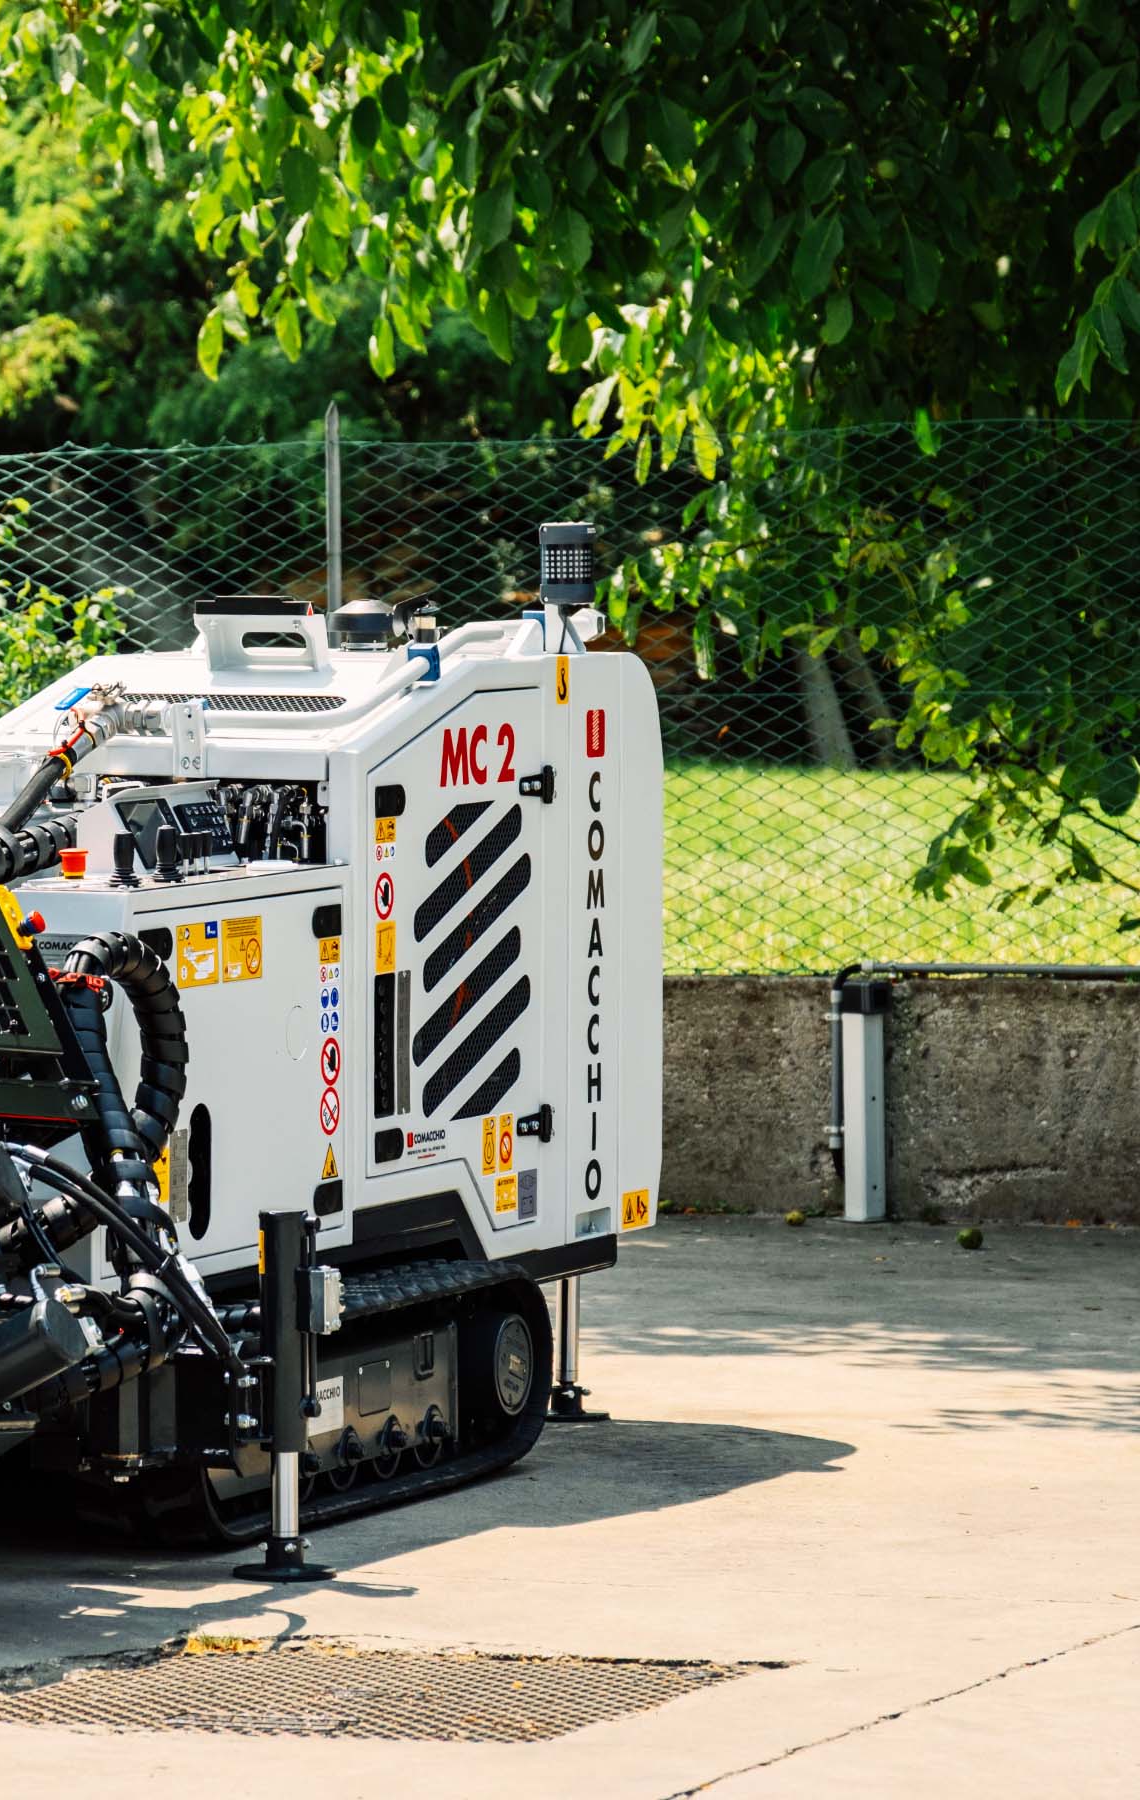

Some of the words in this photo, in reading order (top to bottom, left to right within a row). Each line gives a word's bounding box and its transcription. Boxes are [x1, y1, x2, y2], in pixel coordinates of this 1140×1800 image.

[440, 725, 487, 787] MC
[497, 723, 515, 783] 2
[585, 771, 605, 1200] COMACCHIO
[414, 1130, 445, 1144] COMACCHIO
